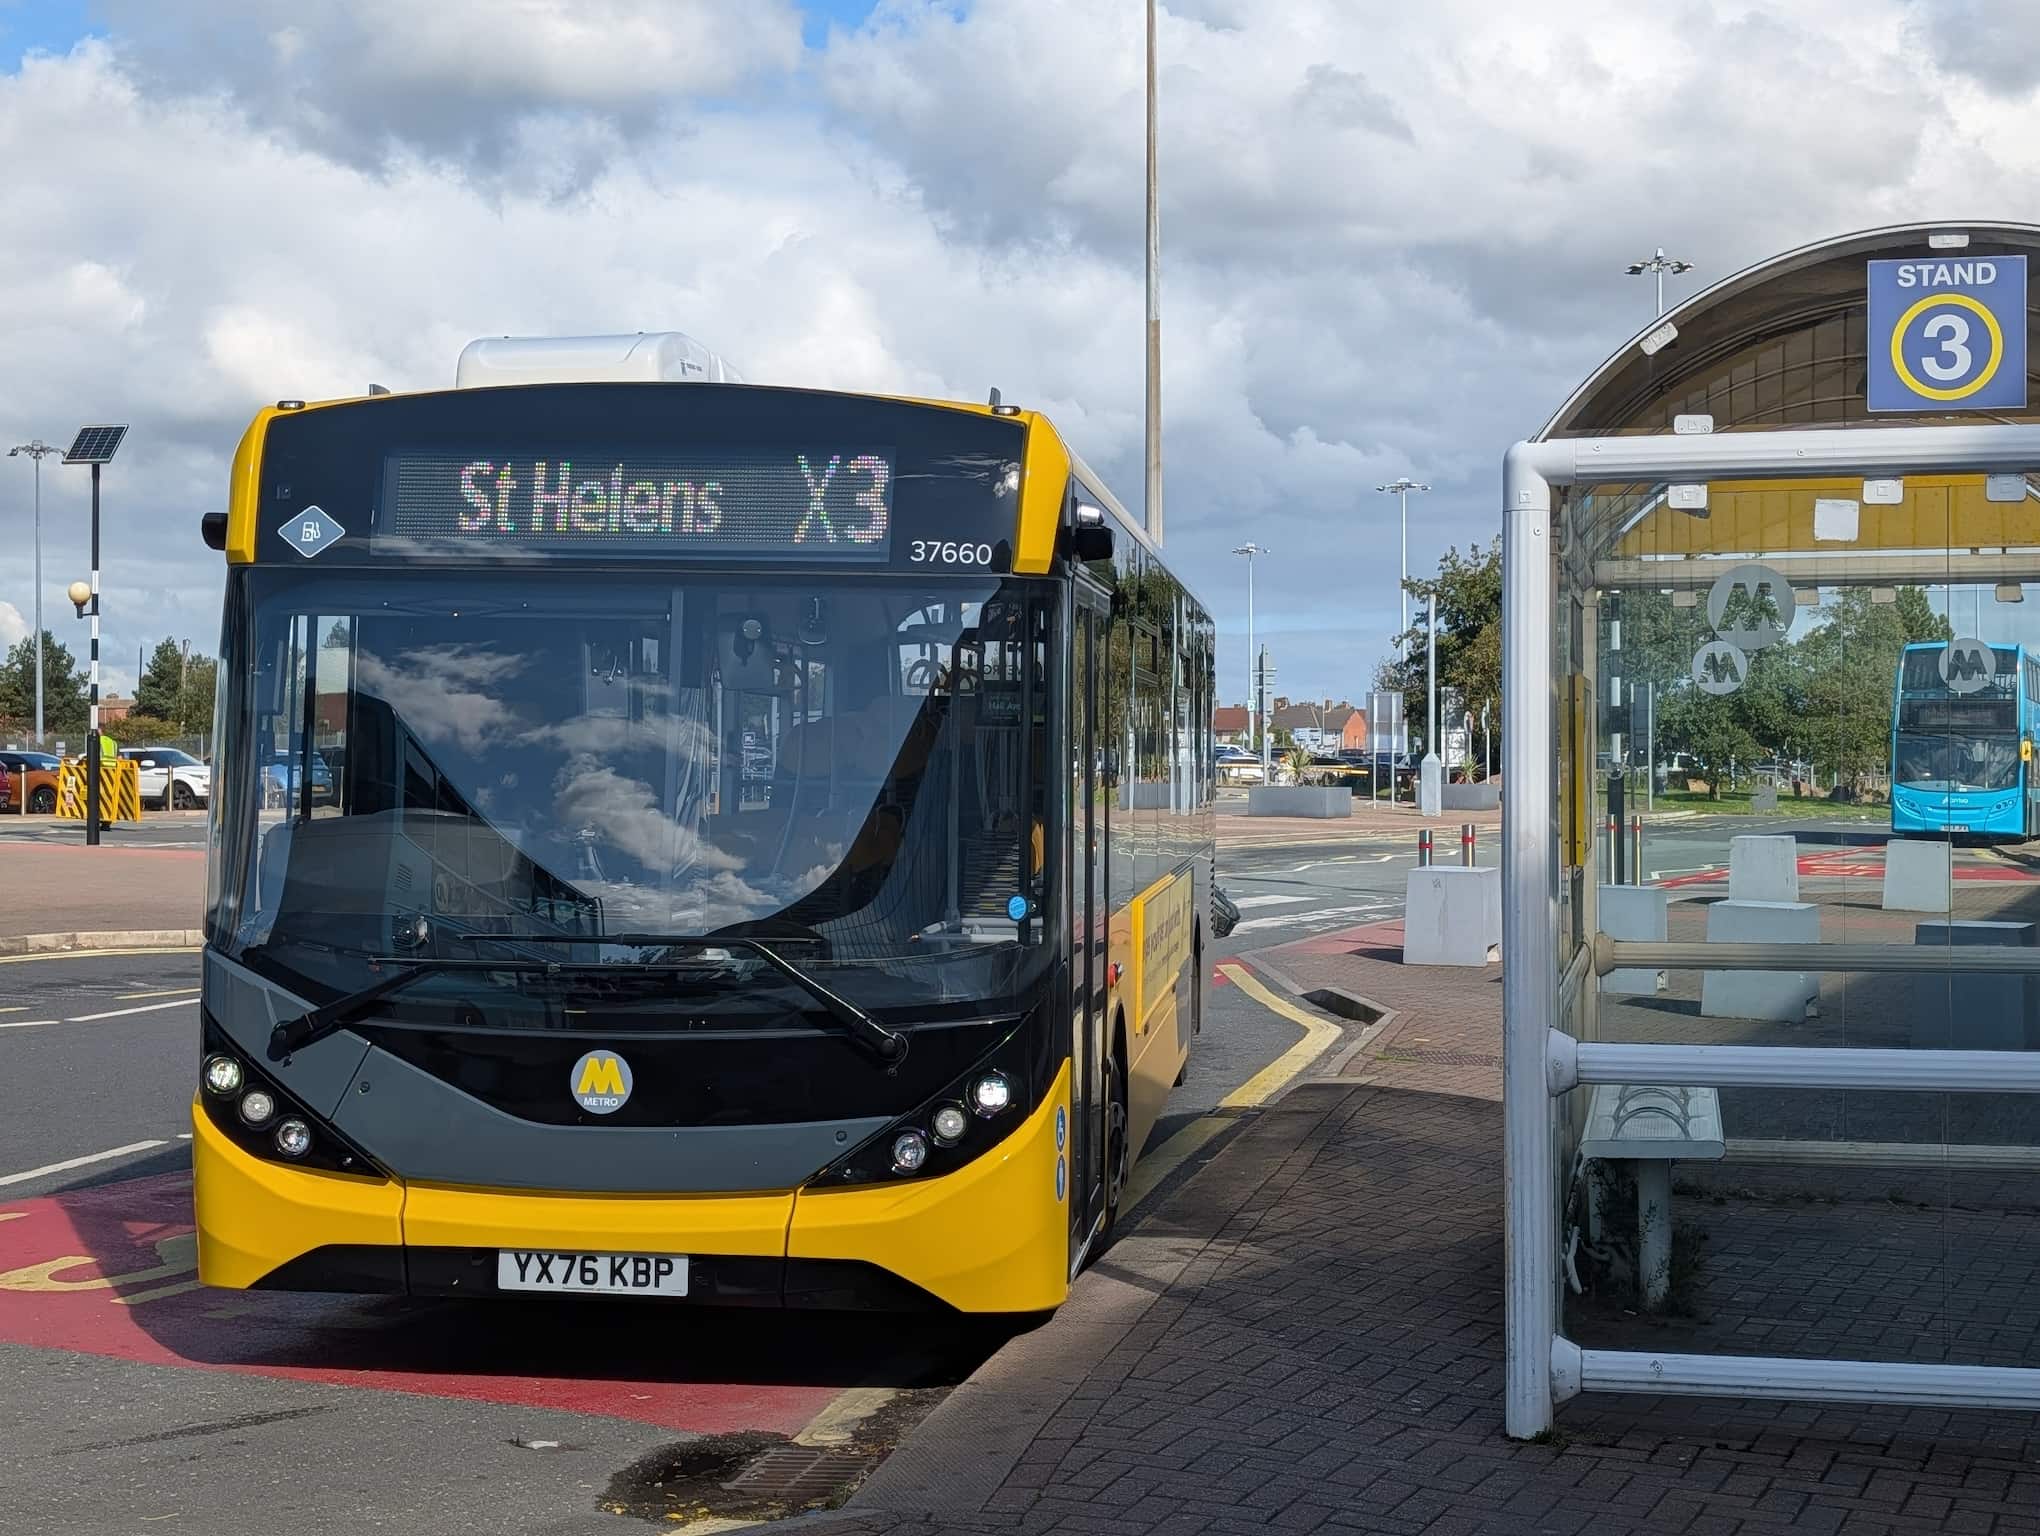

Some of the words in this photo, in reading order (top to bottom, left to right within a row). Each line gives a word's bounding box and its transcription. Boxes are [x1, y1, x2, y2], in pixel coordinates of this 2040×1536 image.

[1897, 262, 1996, 288] STAND
[1921, 314, 1972, 381] 3
[458, 462, 516, 531] St
[532, 462, 723, 532] Helens
[794, 455, 888, 543] X3
[910, 540, 992, 565] 37660
[577, 1057, 625, 1095] M
[583, 1096, 618, 1107] METRO
[514, 1252, 599, 1286] YX76
[609, 1256, 674, 1288] KBP
